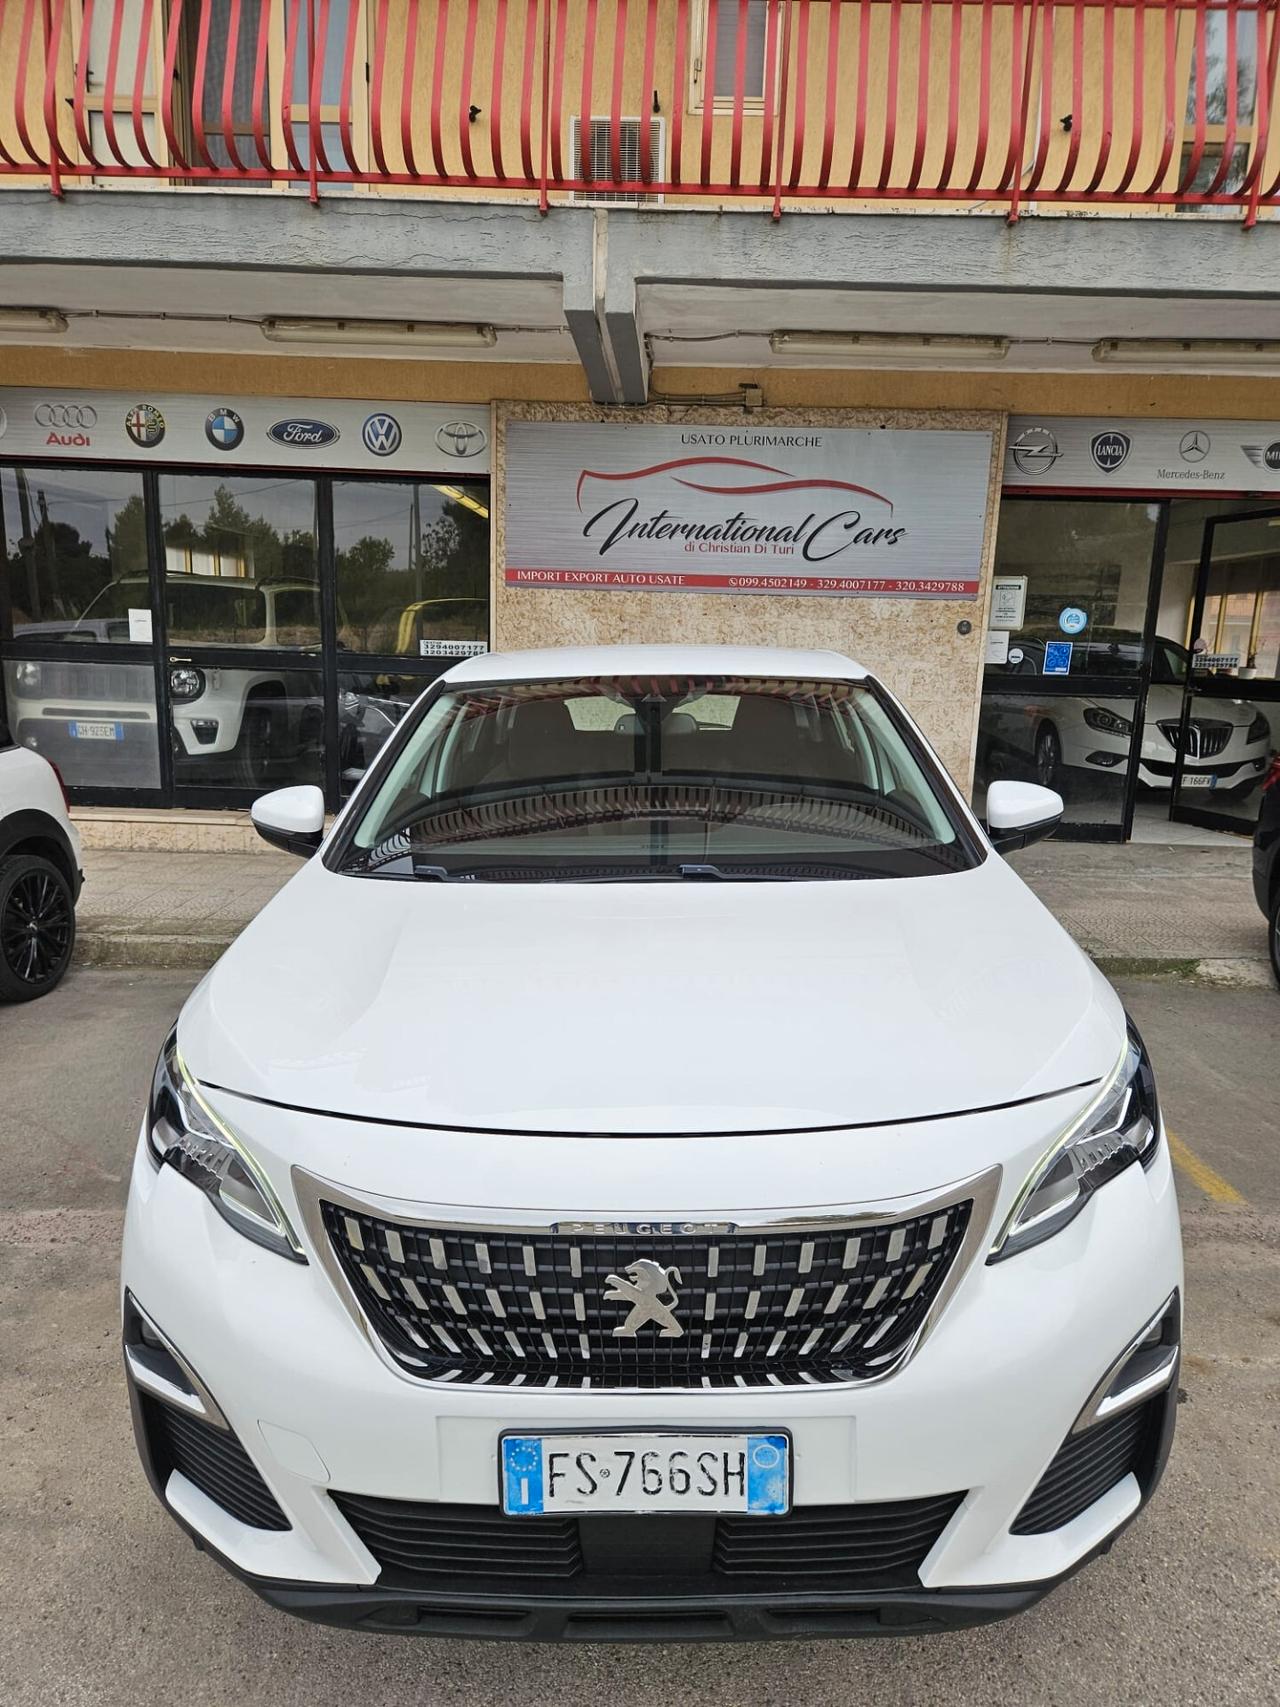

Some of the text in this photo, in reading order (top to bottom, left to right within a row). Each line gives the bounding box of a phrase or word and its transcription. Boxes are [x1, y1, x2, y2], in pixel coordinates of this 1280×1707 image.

[46, 432, 90, 446] Audi
[283, 423, 323, 443] Ford
[681, 434, 823, 447] USATO PLURIMARCHE
[1097, 445, 1123, 456] LANCIA
[1157, 468, 1226, 480] Mercedes-Benz
[583, 498, 910, 562] International Cars
[684, 541, 795, 555] di Christian Di Turi
[517, 570, 686, 585] IMPORT EXPORT AUTO USATE
[738, 577, 808, 588] 099.4502149
[817, 579, 886, 590] 329.4007177
[895, 581, 965, 592] 320.3429788
[570, 1223, 718, 1235] PEUGEOT
